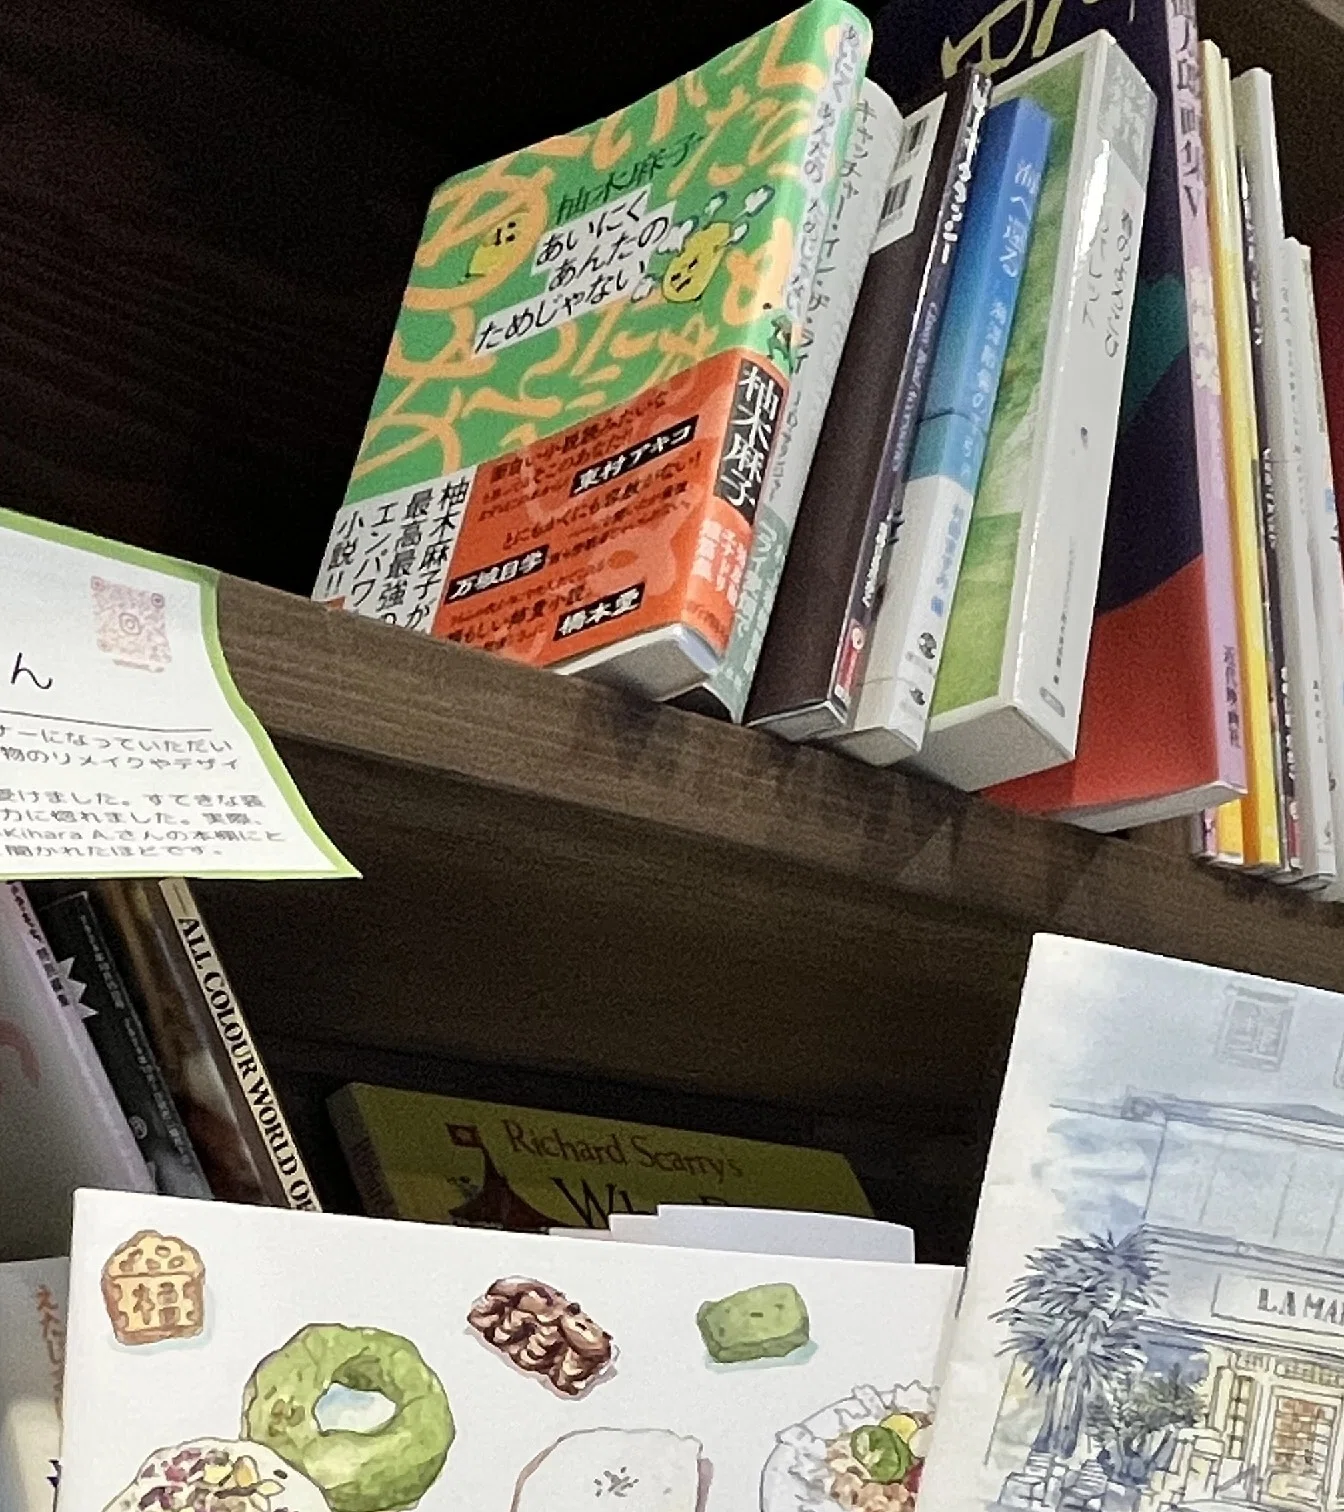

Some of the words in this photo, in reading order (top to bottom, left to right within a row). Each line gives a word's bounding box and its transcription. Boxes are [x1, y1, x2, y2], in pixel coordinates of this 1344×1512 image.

[534, 196, 646, 266] あいにく
[548, 217, 669, 290] あんたの
[476, 258, 647, 353] ためじゃない
[720, 366, 781, 507] 柚木麻子
[178, 914, 213, 972] ALL
[203, 971, 260, 1078] COLOUR
[248, 1077, 299, 1179] WORLD
[502, 1118, 628, 1167] Richard
[631, 1135, 744, 1184] Scarry's
[1258, 1288, 1297, 1317] LA
